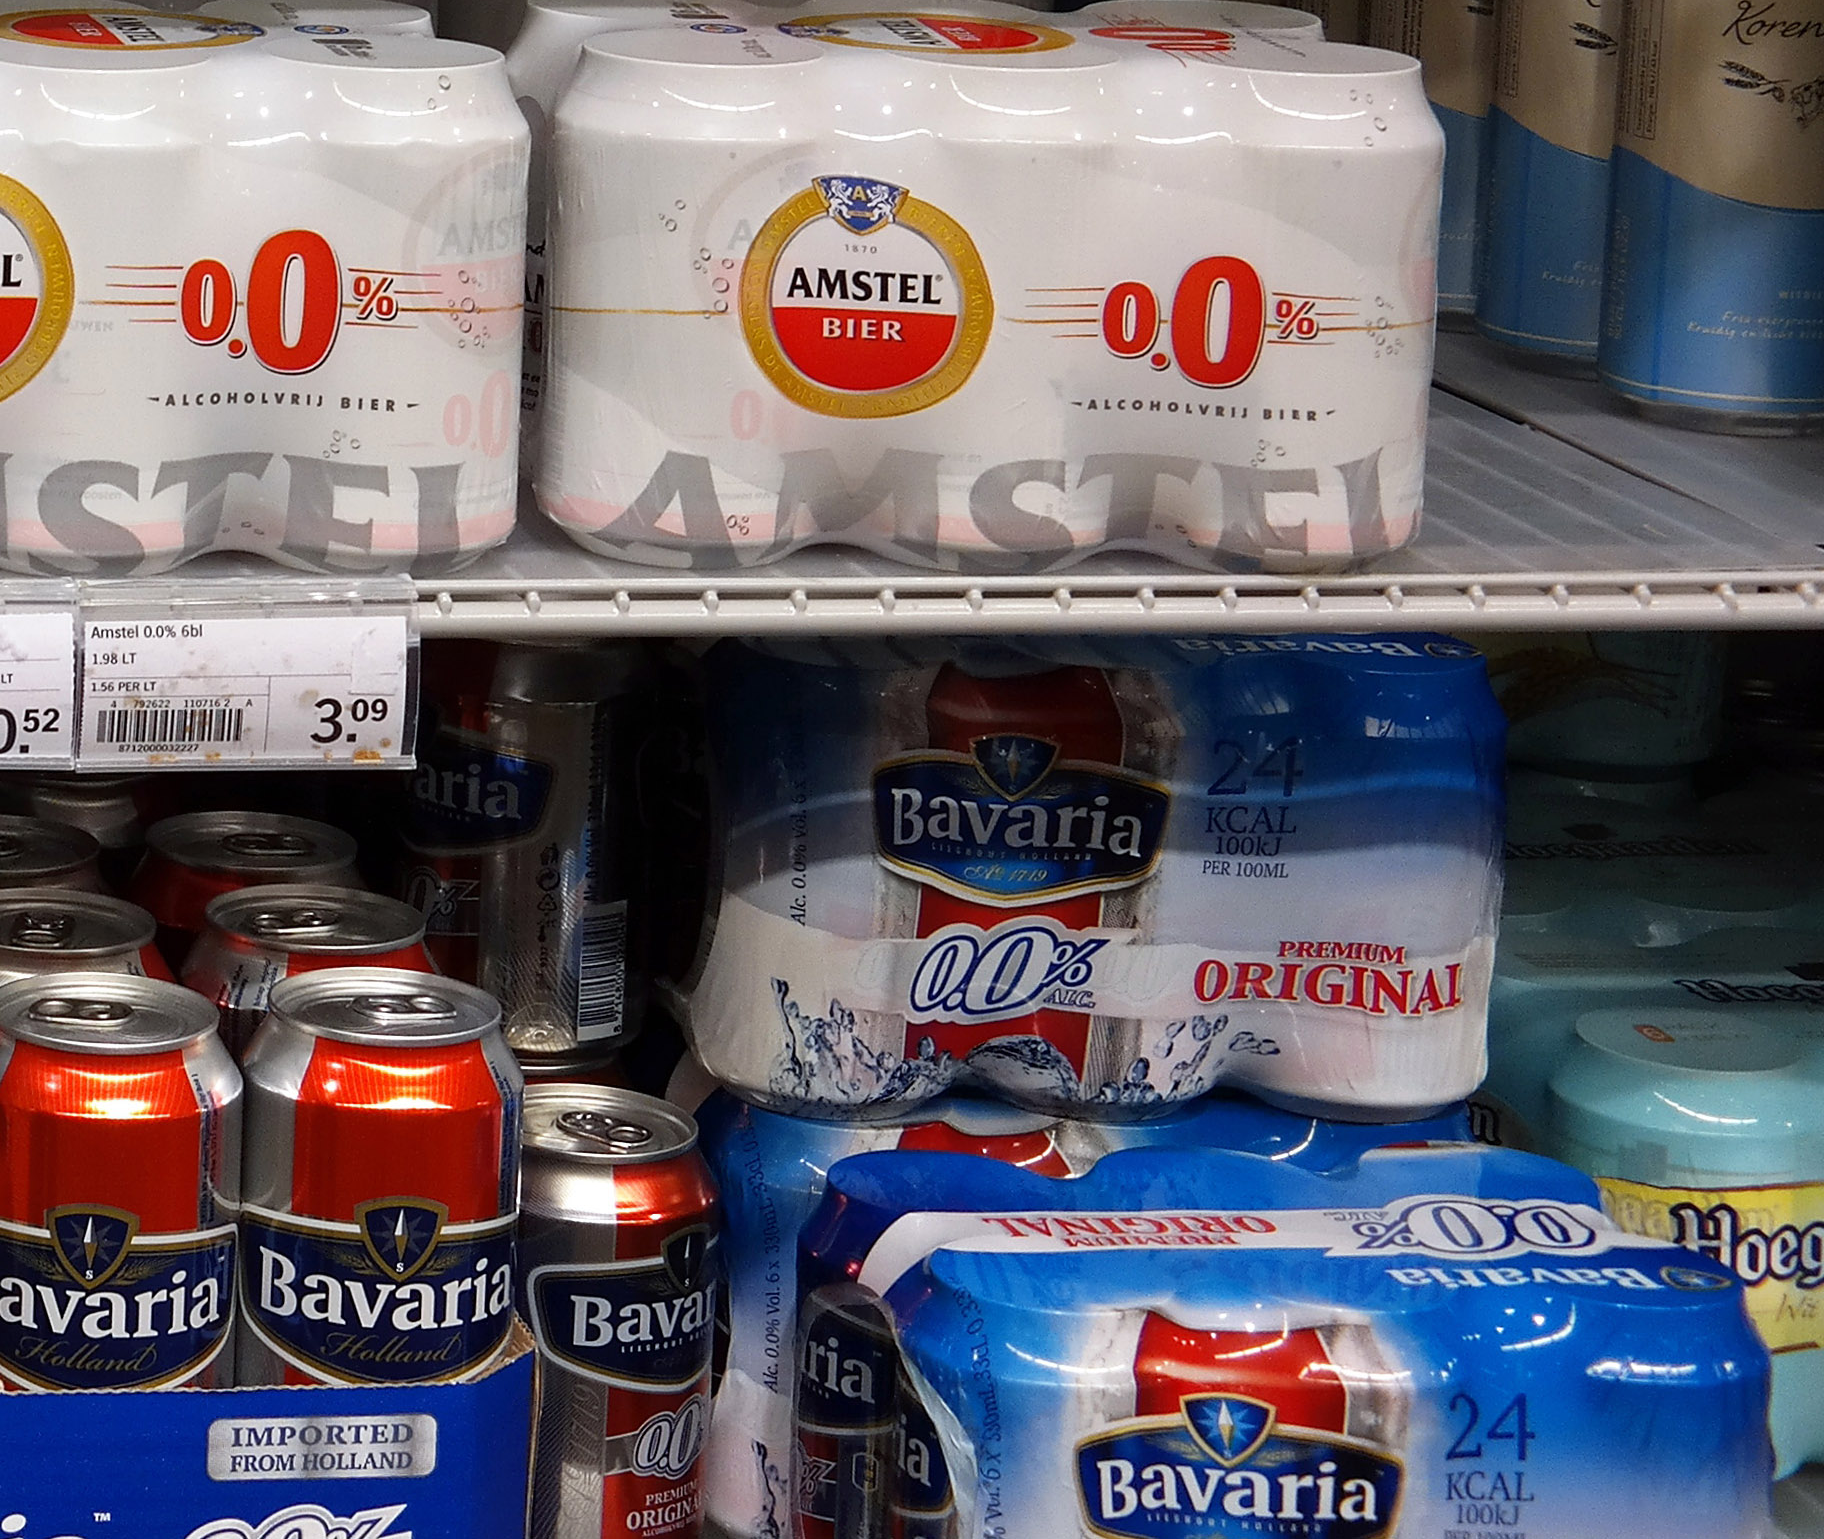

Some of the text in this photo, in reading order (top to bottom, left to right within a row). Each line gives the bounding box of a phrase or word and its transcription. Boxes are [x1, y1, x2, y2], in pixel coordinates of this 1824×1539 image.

[179, 227, 401, 375] 0.0%
[164, 391, 398, 413] ALCOHOLVRIJ BIER
[91, 625, 203, 639] Amstel 0.0% 6bl
[310, 697, 388, 744] 3.09
[891, 787, 1145, 861] Bavaria
[1206, 805, 1297, 835] KCAL
[1278, 941, 1405, 964] PREMIUM
[1194, 961, 1463, 1016] ORIGINAL
[260, 1246, 512, 1332] Bavaria
[320, 1332, 460, 1366] Holland
[230, 1423, 414, 1448] IMPORTED
[229, 1451, 413, 1473] FROM HOLLAND
[1097, 1459, 1378, 1523] Bavaria
